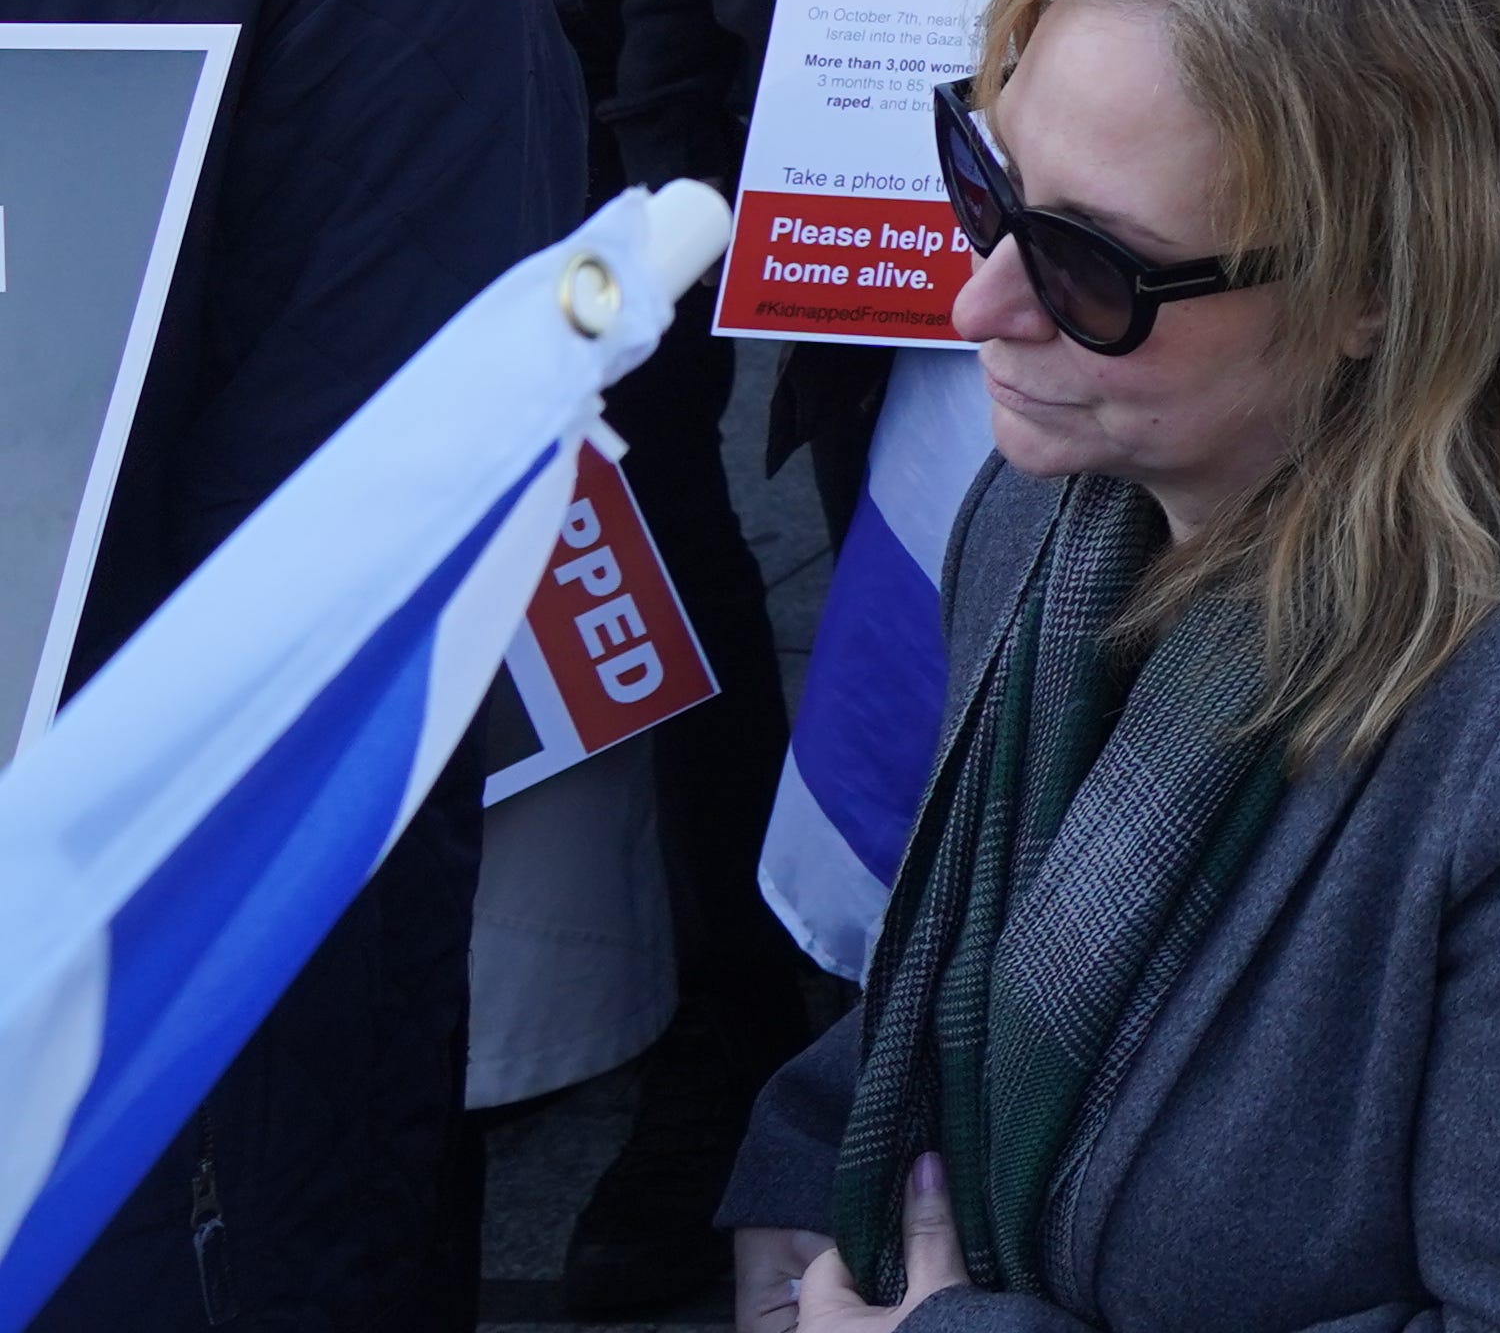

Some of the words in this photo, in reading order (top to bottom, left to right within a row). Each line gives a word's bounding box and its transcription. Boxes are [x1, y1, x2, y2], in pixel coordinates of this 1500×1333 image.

[805, 54, 843, 71] More
[847, 56, 882, 73] than
[885, 57, 924, 75] 3,000
[826, 94, 874, 113] raped,
[770, 217, 872, 250] Please
[880, 223, 944, 255] help
[763, 255, 850, 288] home
[858, 260, 935, 291] alive.
[754, 298, 951, 327] #KidnappedFromIsrael
